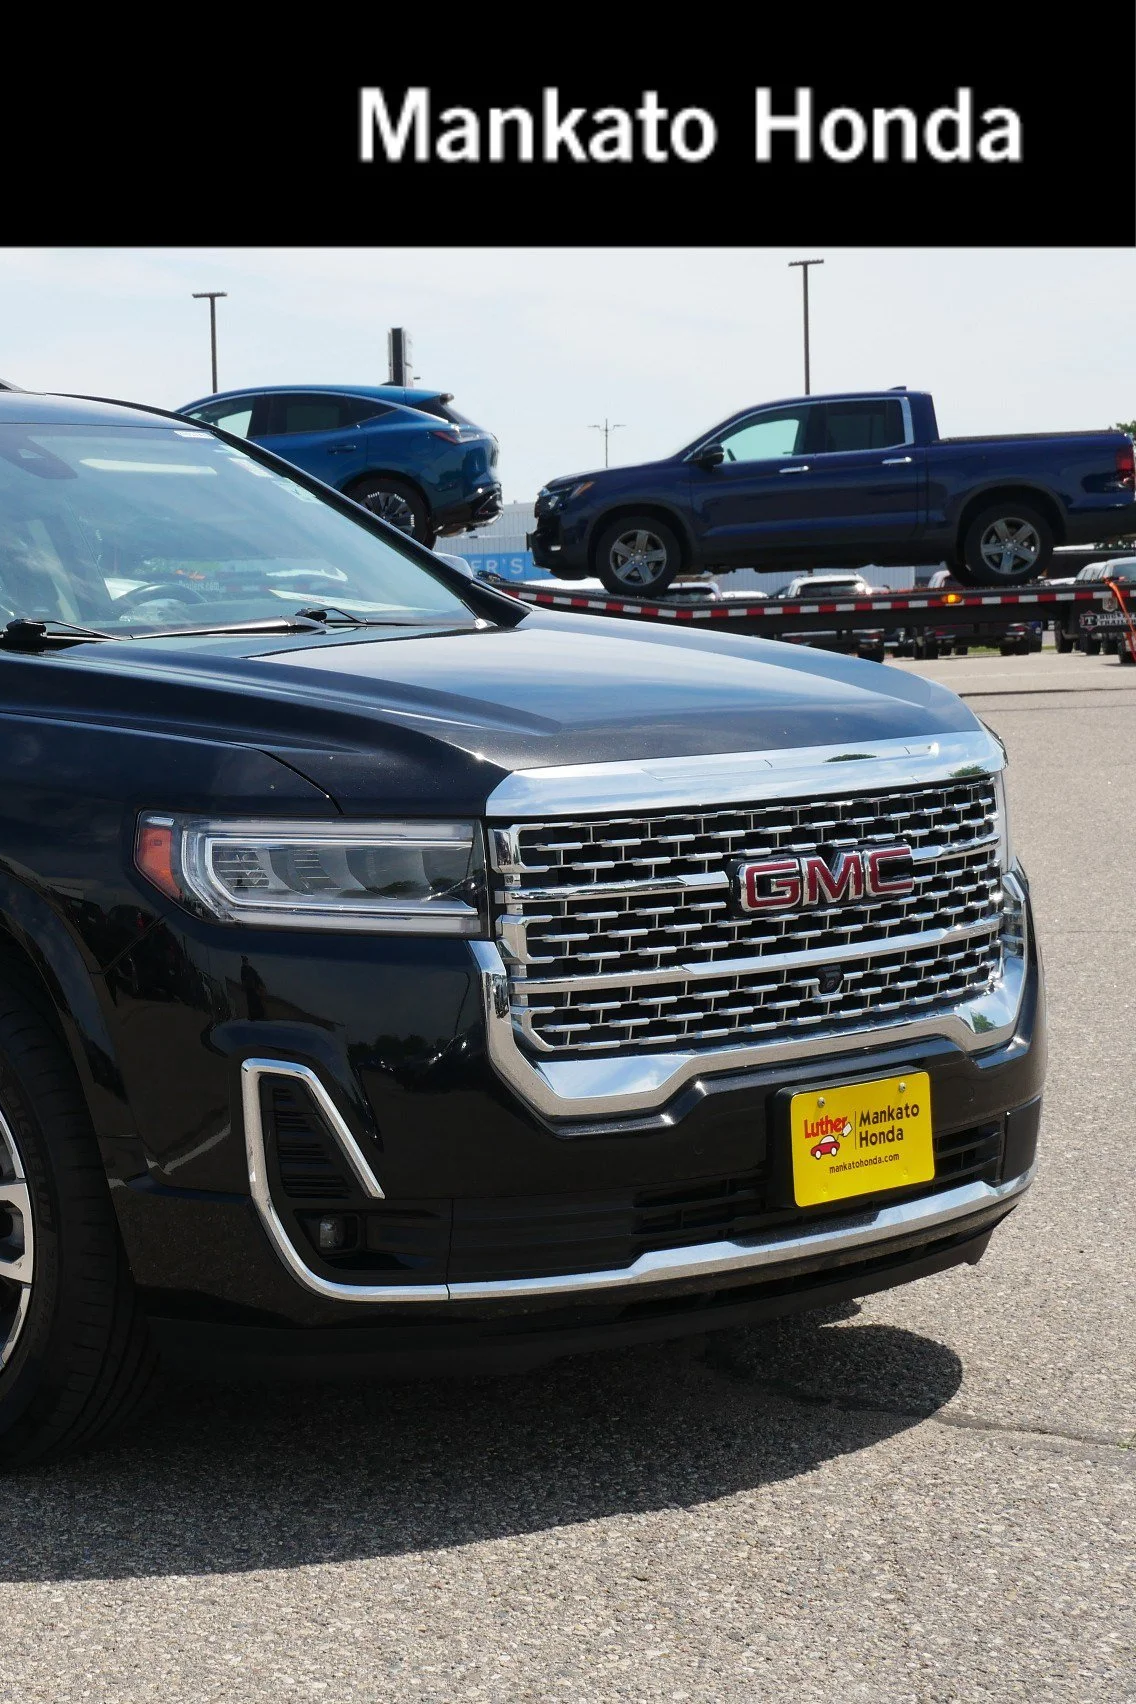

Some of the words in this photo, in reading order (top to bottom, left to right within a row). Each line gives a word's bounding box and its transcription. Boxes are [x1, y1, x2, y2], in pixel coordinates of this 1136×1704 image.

[739, 845, 914, 912] GMC
[804, 1115, 848, 1139] Luther
[859, 1103, 920, 1127] Mankato
[859, 1125, 904, 1148] Honda
[829, 1152, 900, 1174] mankatohonda.com
